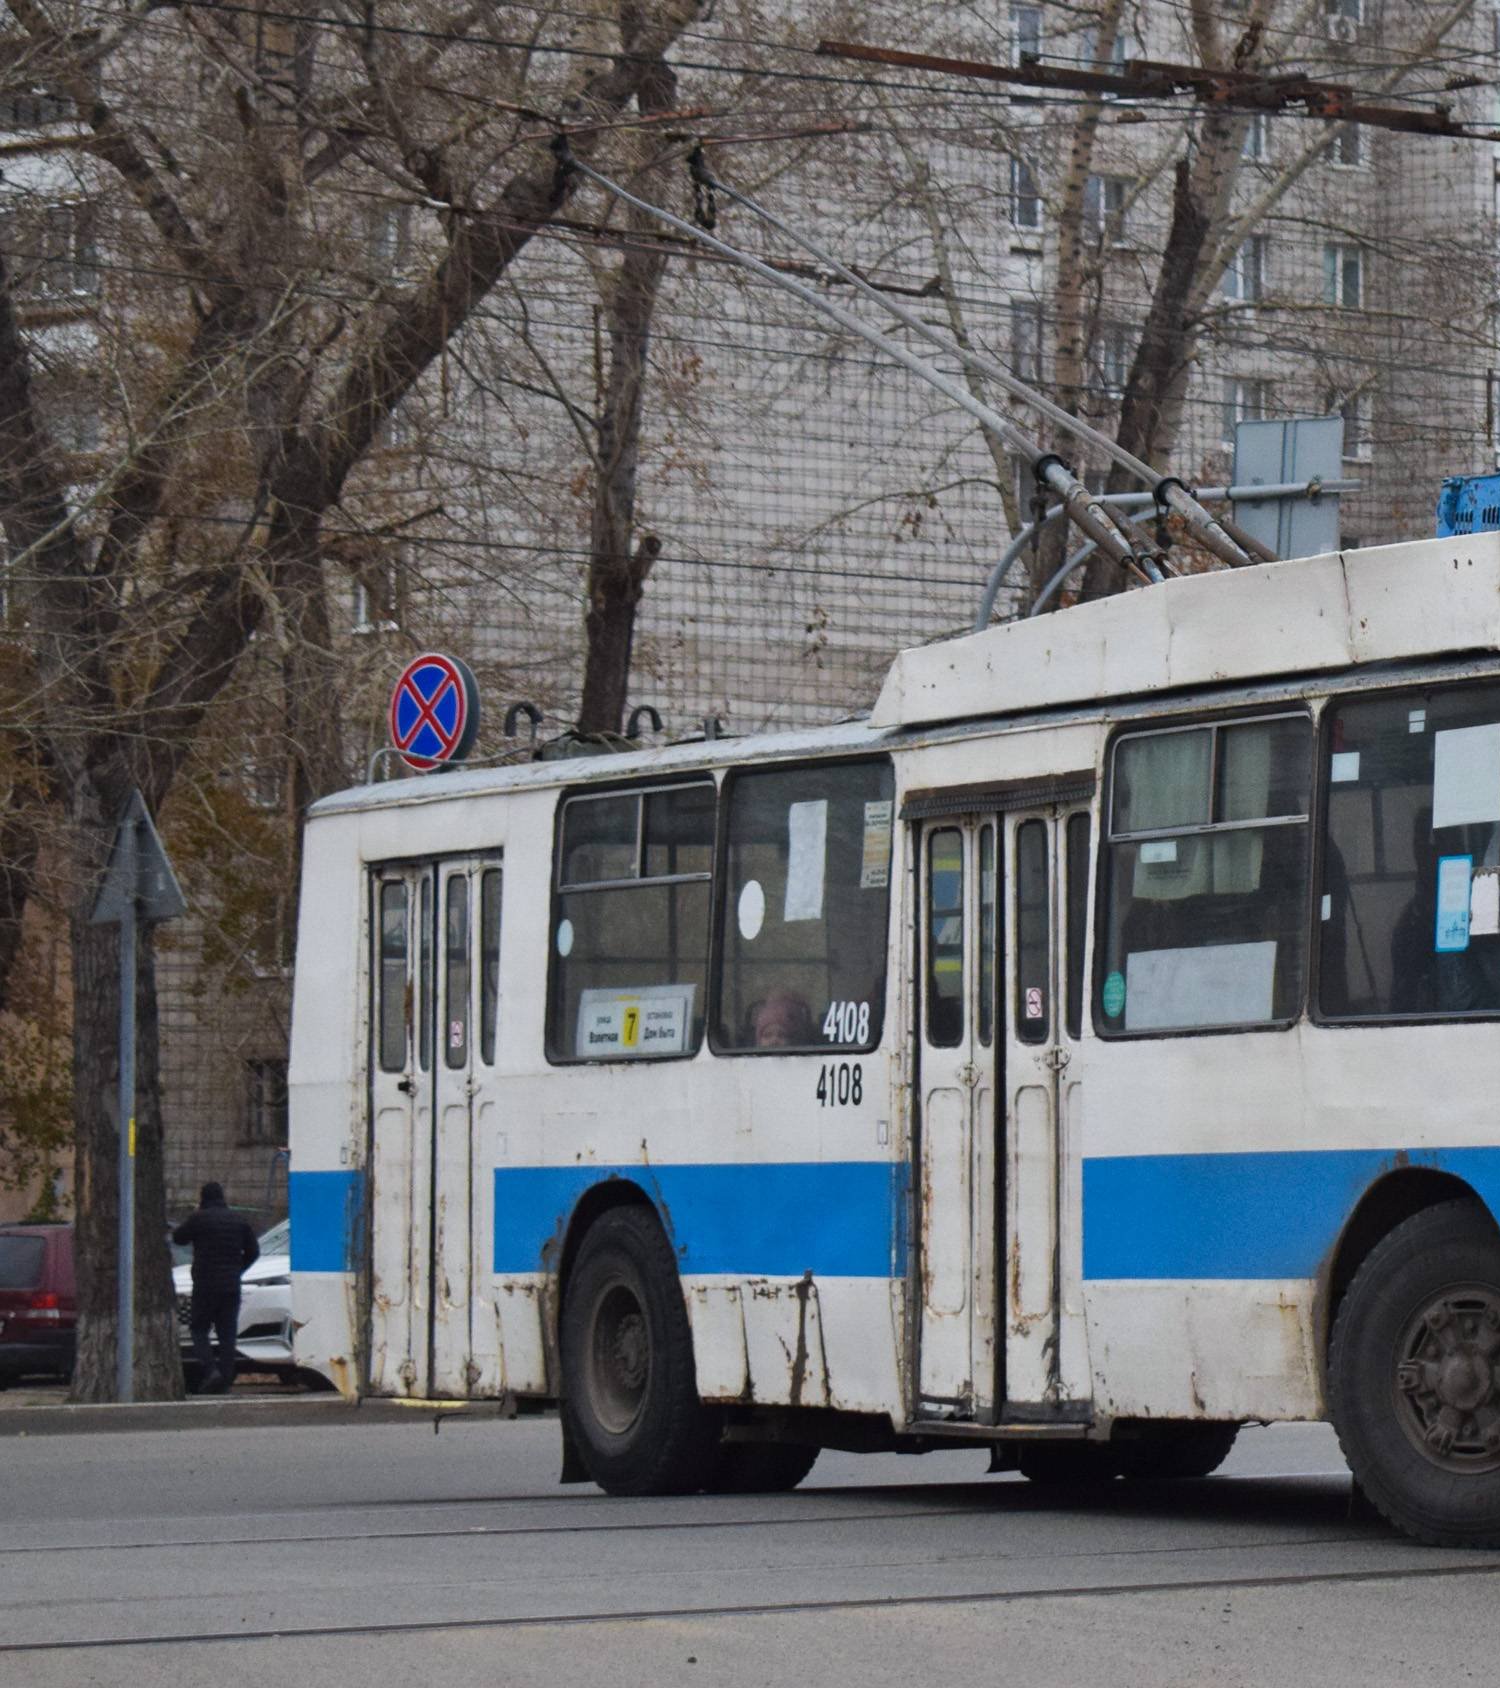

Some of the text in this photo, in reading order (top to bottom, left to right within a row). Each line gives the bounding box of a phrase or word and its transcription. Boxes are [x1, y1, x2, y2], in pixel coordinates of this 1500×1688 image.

[628, 1012, 636, 1041] 7
[823, 1001, 870, 1045] 4108
[816, 1062, 863, 1108] 4108
